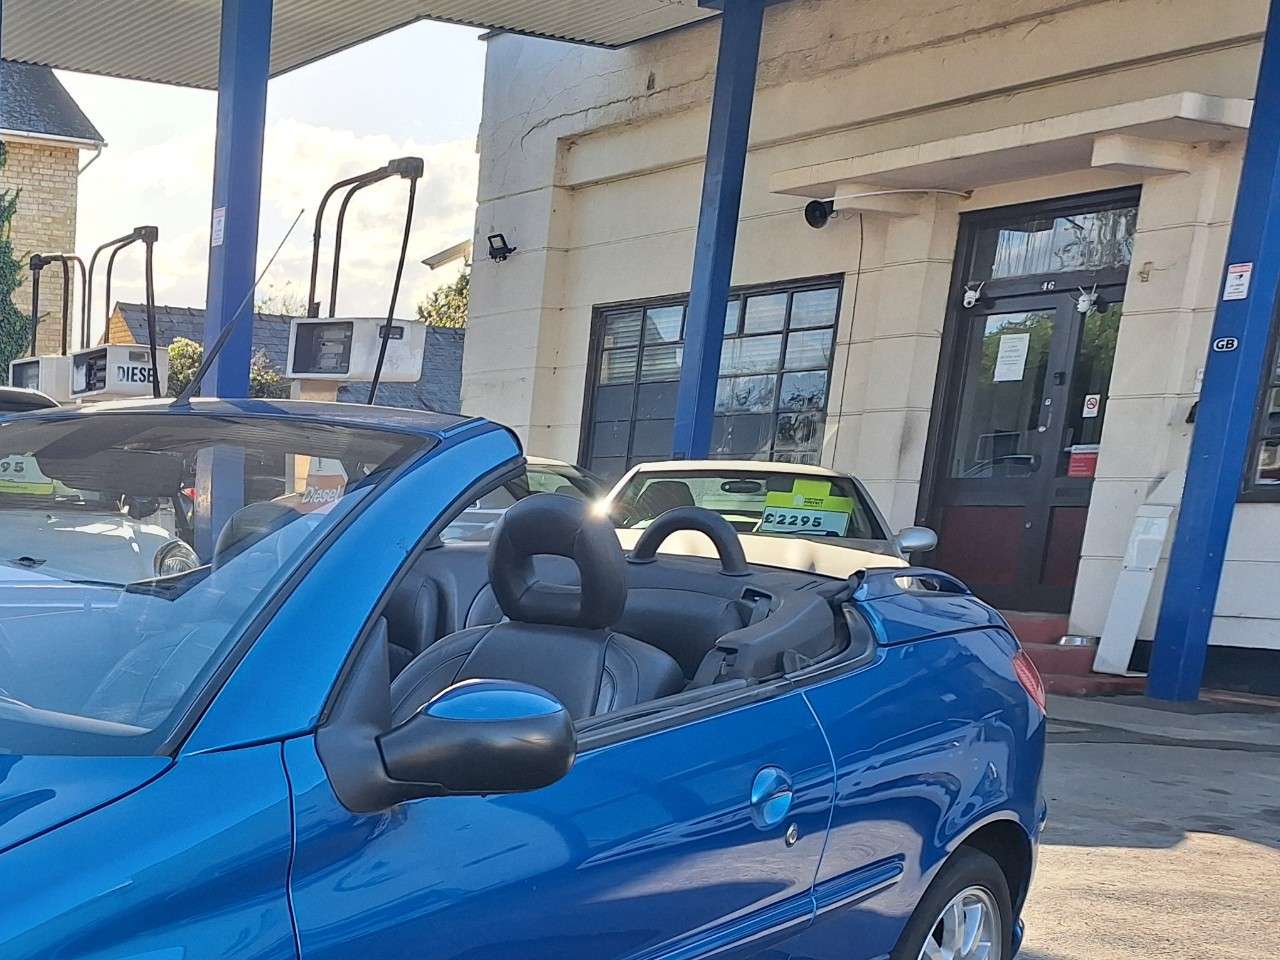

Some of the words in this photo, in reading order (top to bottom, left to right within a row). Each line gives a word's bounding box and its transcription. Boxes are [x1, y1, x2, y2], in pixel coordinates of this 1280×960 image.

[1041, 281, 1056, 291] 46
[1215, 339, 1236, 350] GB
[117, 365, 160, 384] DIESE
[764, 512, 822, 528] £2295
